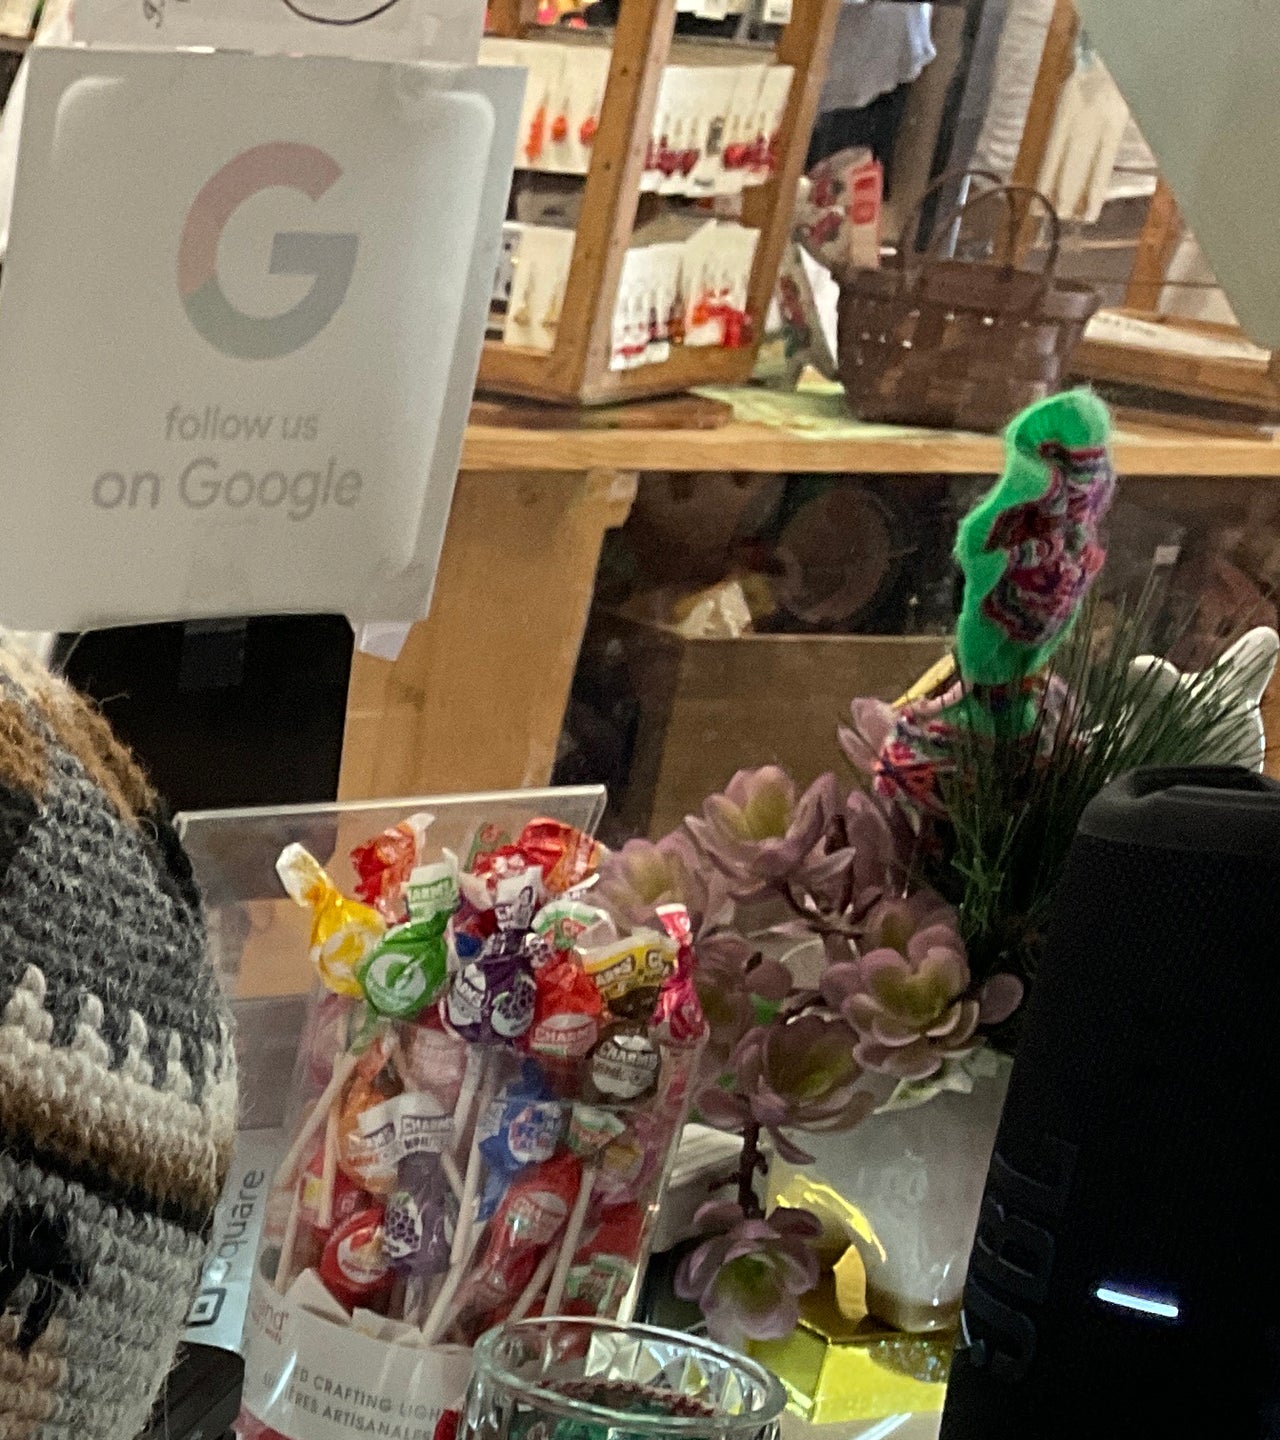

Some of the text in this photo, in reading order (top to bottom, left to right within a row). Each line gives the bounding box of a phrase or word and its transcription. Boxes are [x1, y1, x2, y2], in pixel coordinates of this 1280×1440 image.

[165, 404, 319, 441] follow us
[92, 455, 363, 523] on Google
[314, 1376, 393, 1413] CRAFTING
[398, 1402, 441, 1422] LIGH
